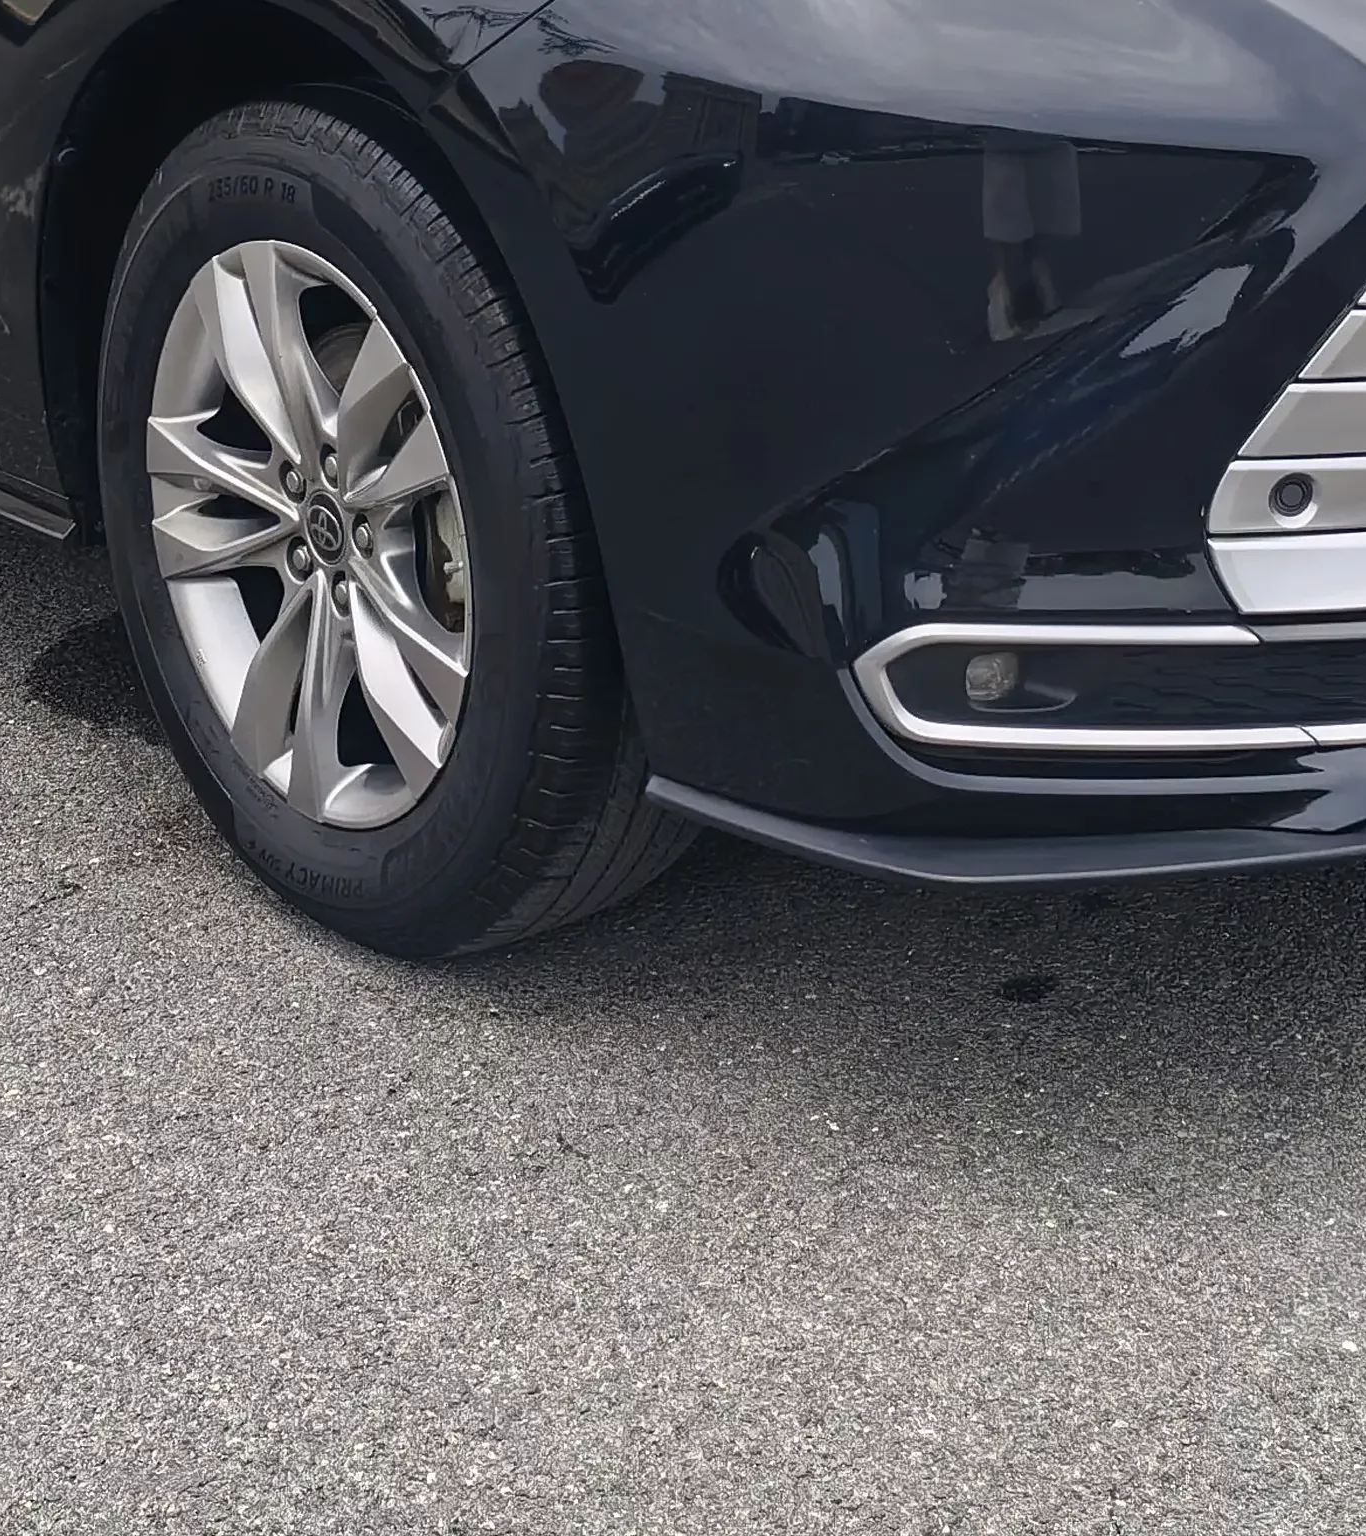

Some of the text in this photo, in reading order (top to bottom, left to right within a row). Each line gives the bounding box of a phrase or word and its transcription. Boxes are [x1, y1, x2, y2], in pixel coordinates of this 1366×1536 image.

[264, 177, 275, 197] R
[281, 182, 296, 204] 18
[286, 862, 363, 898] PRIMACY
